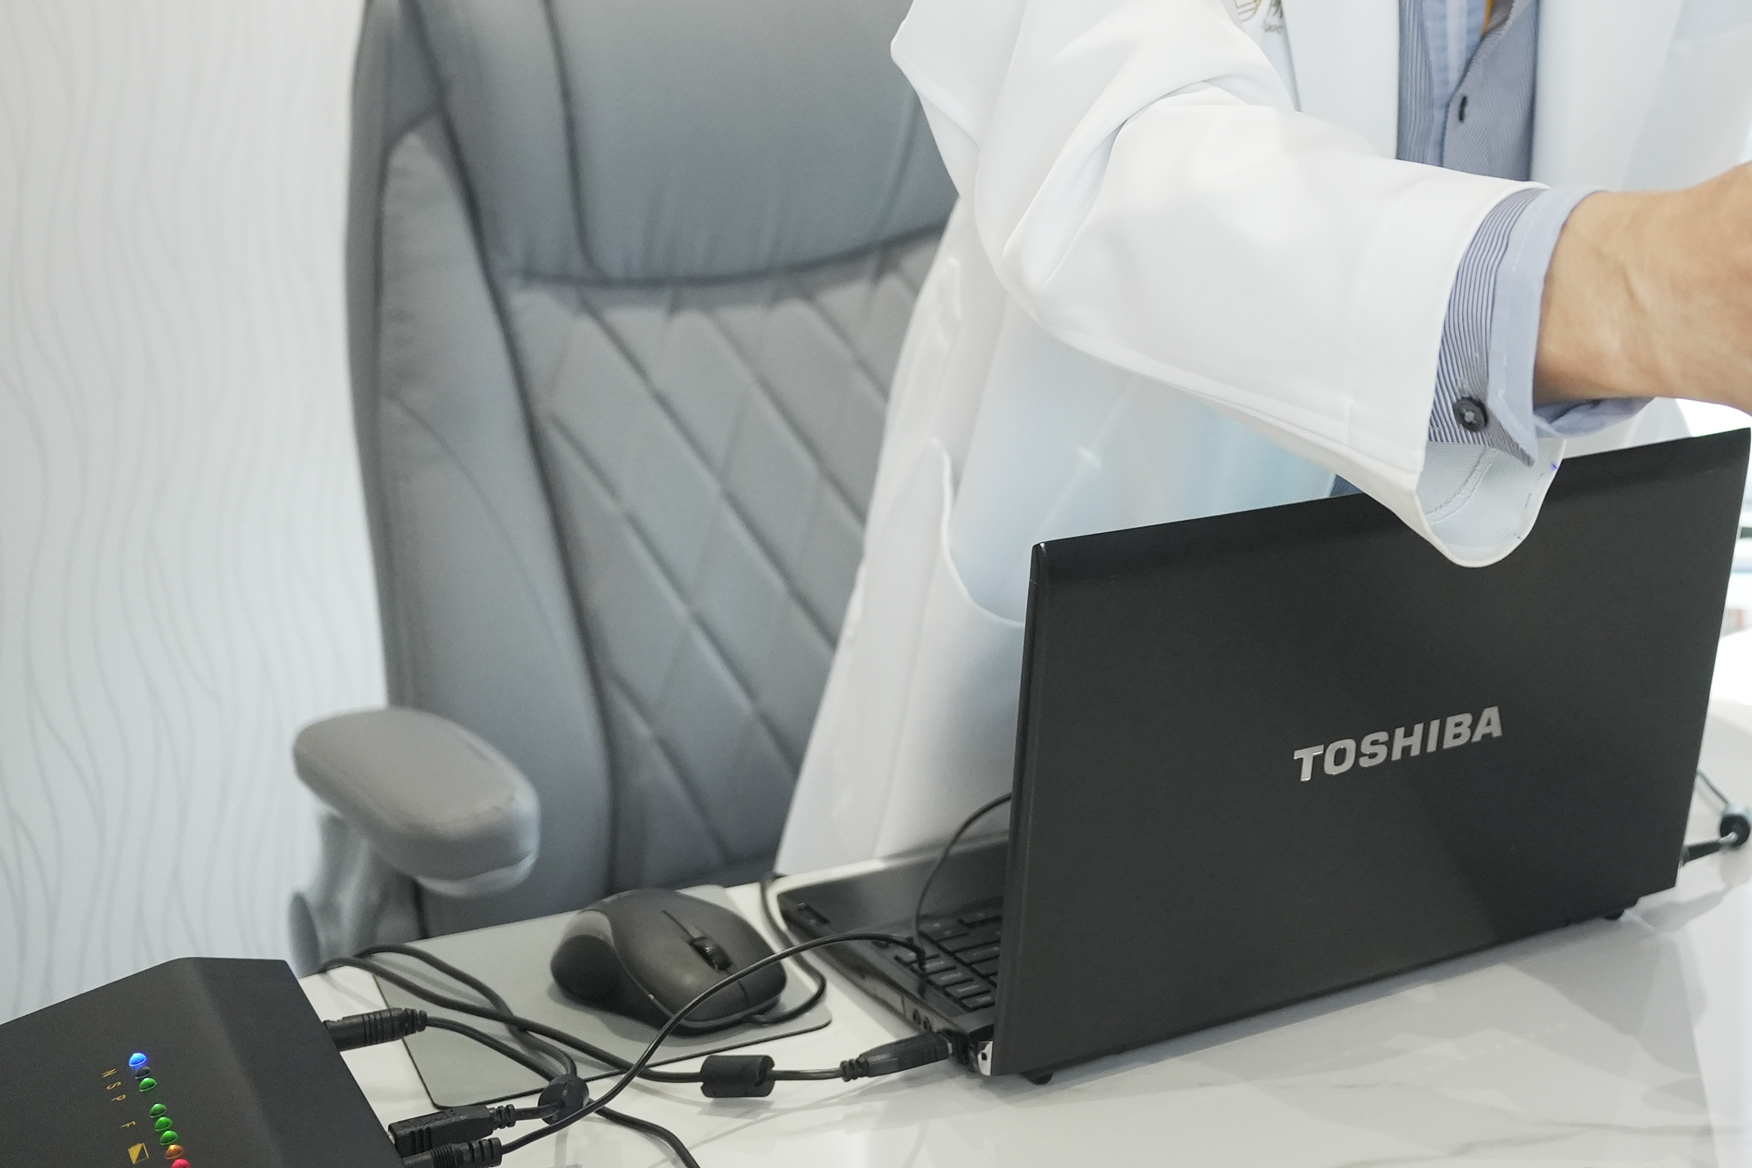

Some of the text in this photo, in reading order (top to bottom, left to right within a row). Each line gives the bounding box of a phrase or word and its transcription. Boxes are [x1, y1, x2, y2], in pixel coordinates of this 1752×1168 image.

[1293, 705, 1503, 782] TOSHIBA
[106, 1081, 122, 1090] S
[111, 1094, 127, 1102] P
